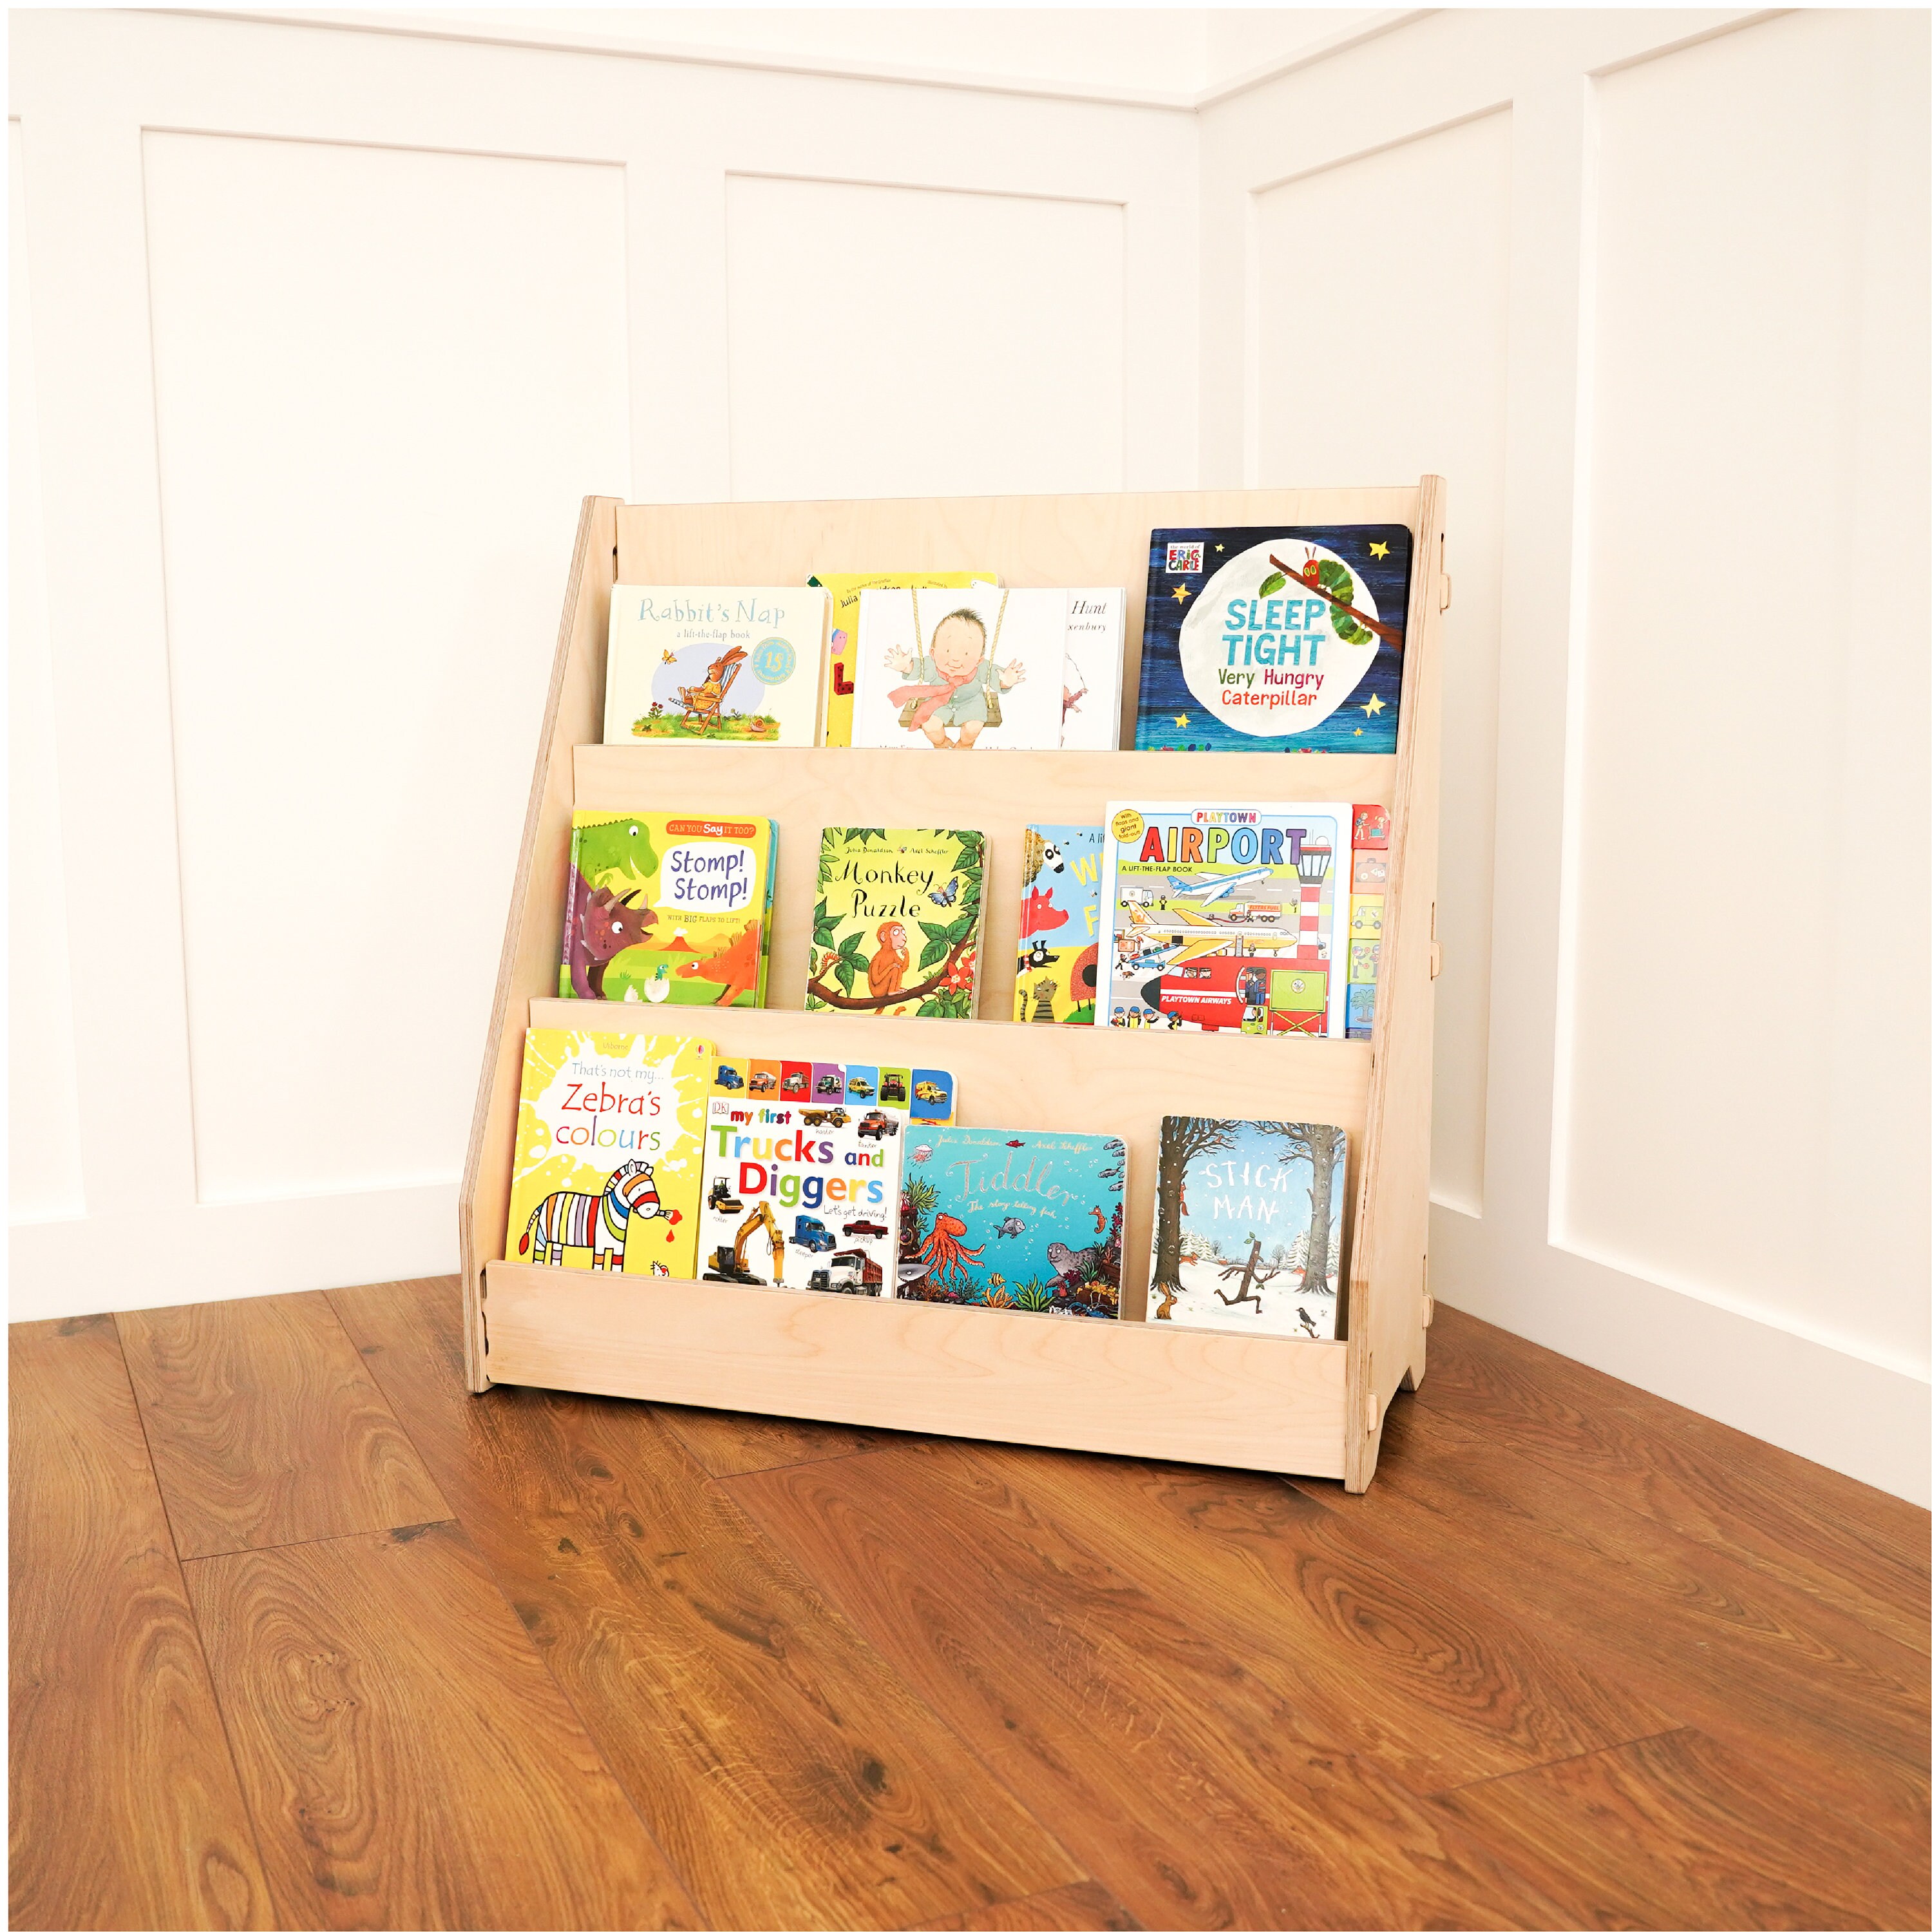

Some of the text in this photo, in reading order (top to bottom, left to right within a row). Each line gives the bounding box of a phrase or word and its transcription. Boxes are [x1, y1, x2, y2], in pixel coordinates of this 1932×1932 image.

[1168, 560, 1199, 571] CARLE
[840, 594, 858, 608] Julia
[1070, 600, 1107, 614] Hunt
[637, 598, 785, 629] Rabbit's Nap
[1224, 598, 1326, 632] SLEEP
[730, 630, 751, 639] book
[1066, 621, 1106, 634] xenbury
[1222, 632, 1326, 667] TIGHT
[764, 650, 784, 673] 15
[1218, 668, 1325, 690] Very Hungry
[1222, 690, 1318, 710] Caterpillar
[1120, 823, 1137, 833] giant
[1196, 811, 1256, 823] PLAYTOWN
[669, 824, 685, 832] CAN
[687, 824, 703, 833] YOU
[703, 824, 723, 837] Say
[734, 826, 754, 835] TOO?
[1139, 826, 1307, 866] AIRPORT
[670, 849, 744, 880] Stomp!
[835, 860, 934, 896] Monkey
[674, 877, 748, 907] Stomp!
[851, 888, 921, 919] Puzzle
[684, 914, 697, 923] BIG
[603, 1042, 629, 1050] Usborne
[572, 1061, 607, 1077] That's
[609, 1066, 631, 1079] not
[561, 1081, 661, 1116] Zebra's
[713, 1101, 728, 1113] DK
[730, 1108, 791, 1126] my first
[556, 1115, 661, 1151] colours
[710, 1124, 884, 1168] Trucks and
[738, 1161, 884, 1209] Diggers
[946, 1151, 1072, 1207] Tiddler
[1199, 1160, 1294, 1193] STICK
[824, 1205, 888, 1222] Let's get driving!
[967, 1199, 984, 1213] The
[1213, 1193, 1280, 1224] MAN
